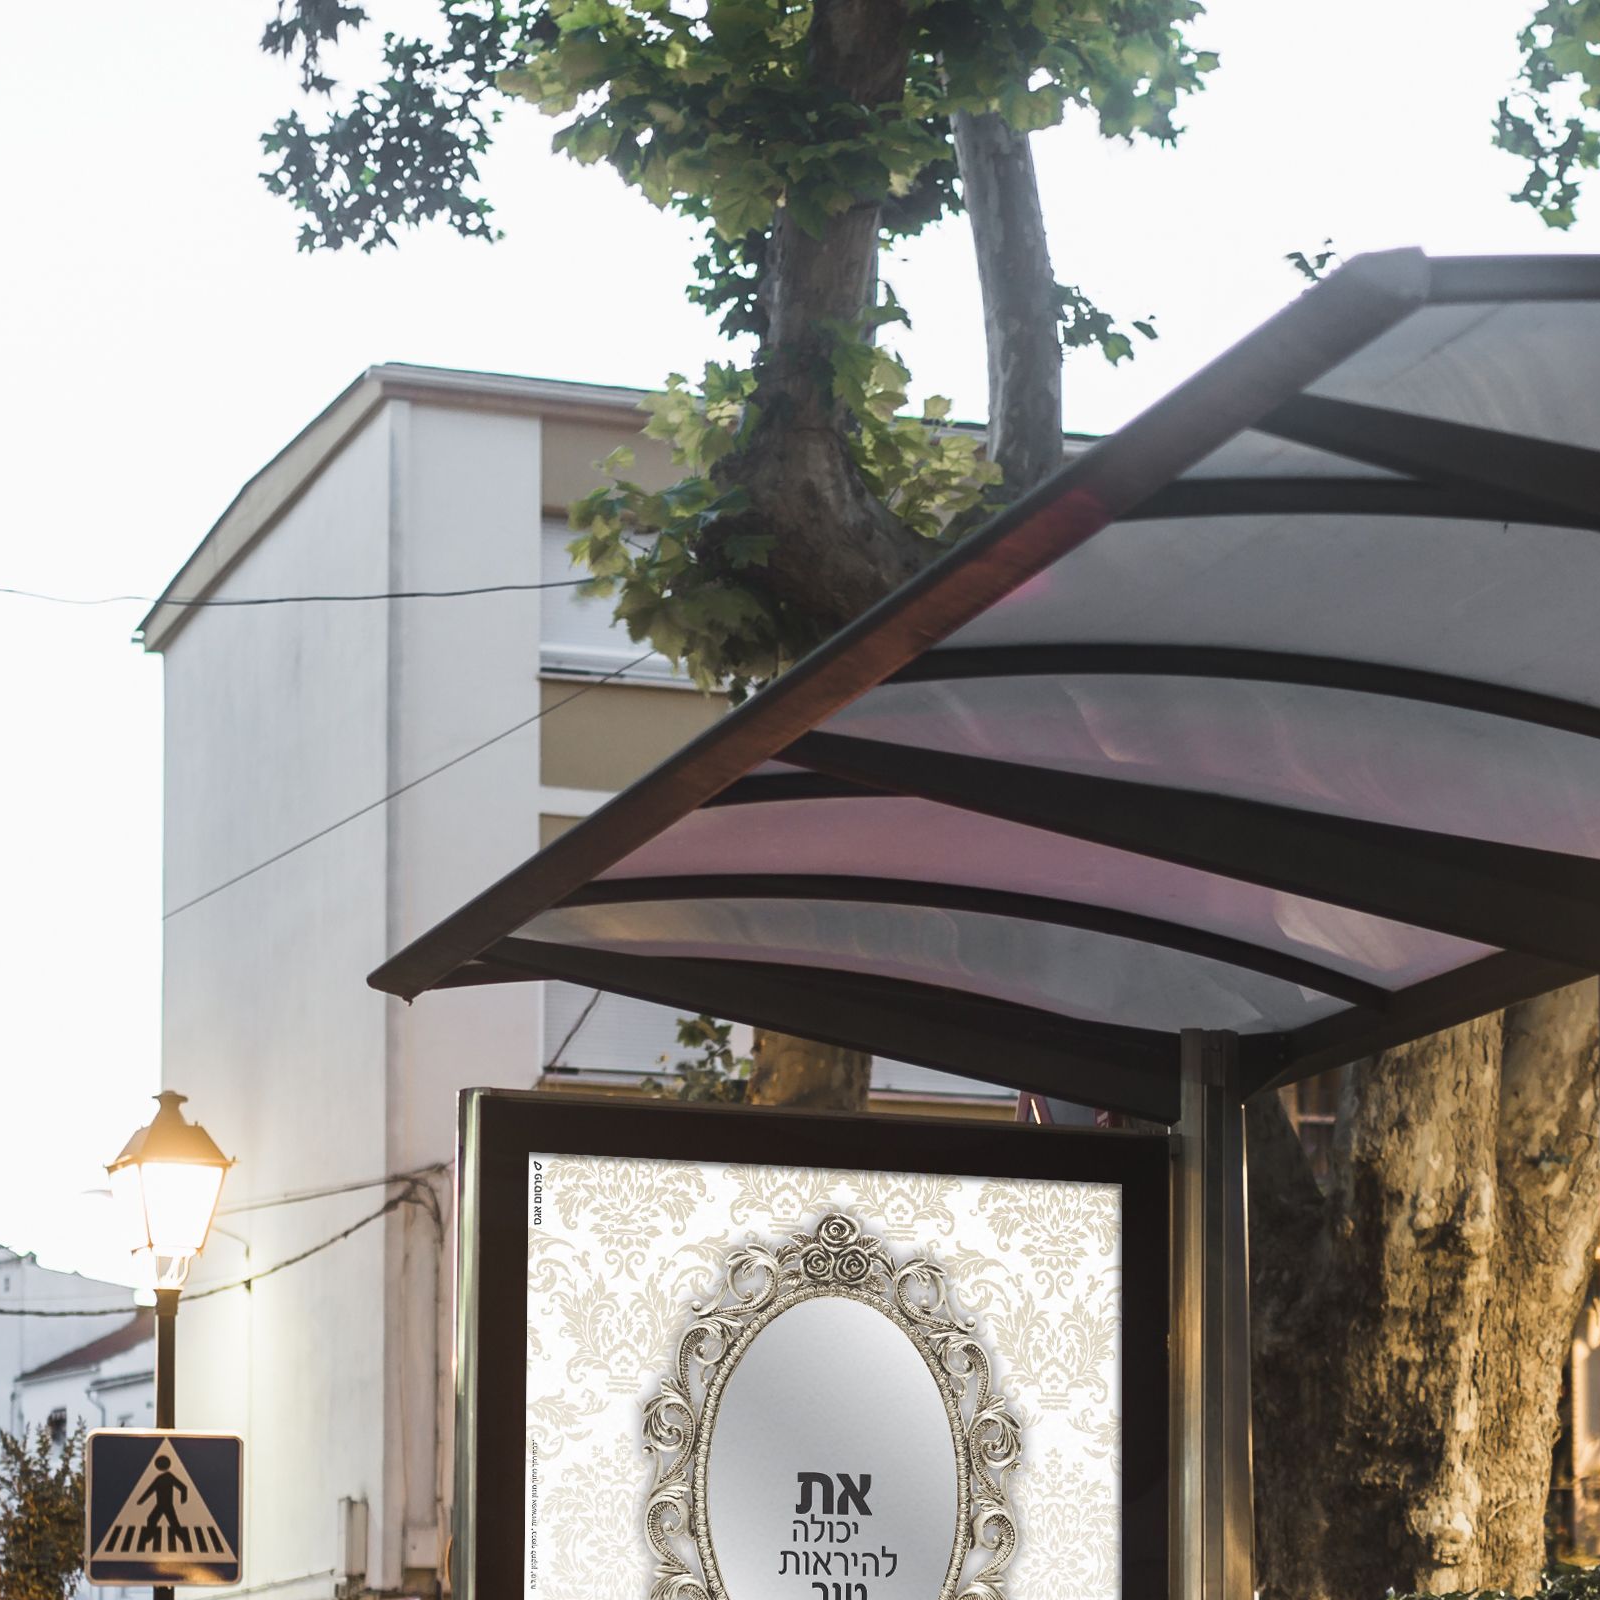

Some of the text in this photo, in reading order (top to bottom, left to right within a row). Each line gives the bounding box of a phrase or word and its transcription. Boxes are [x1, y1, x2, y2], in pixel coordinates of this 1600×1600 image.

[533, 1173, 543, 1225] פרסום אגס
[796, 1471, 872, 1516] את
[792, 1515, 859, 1544] יכולה
[778, 1547, 897, 1578] להיראות
